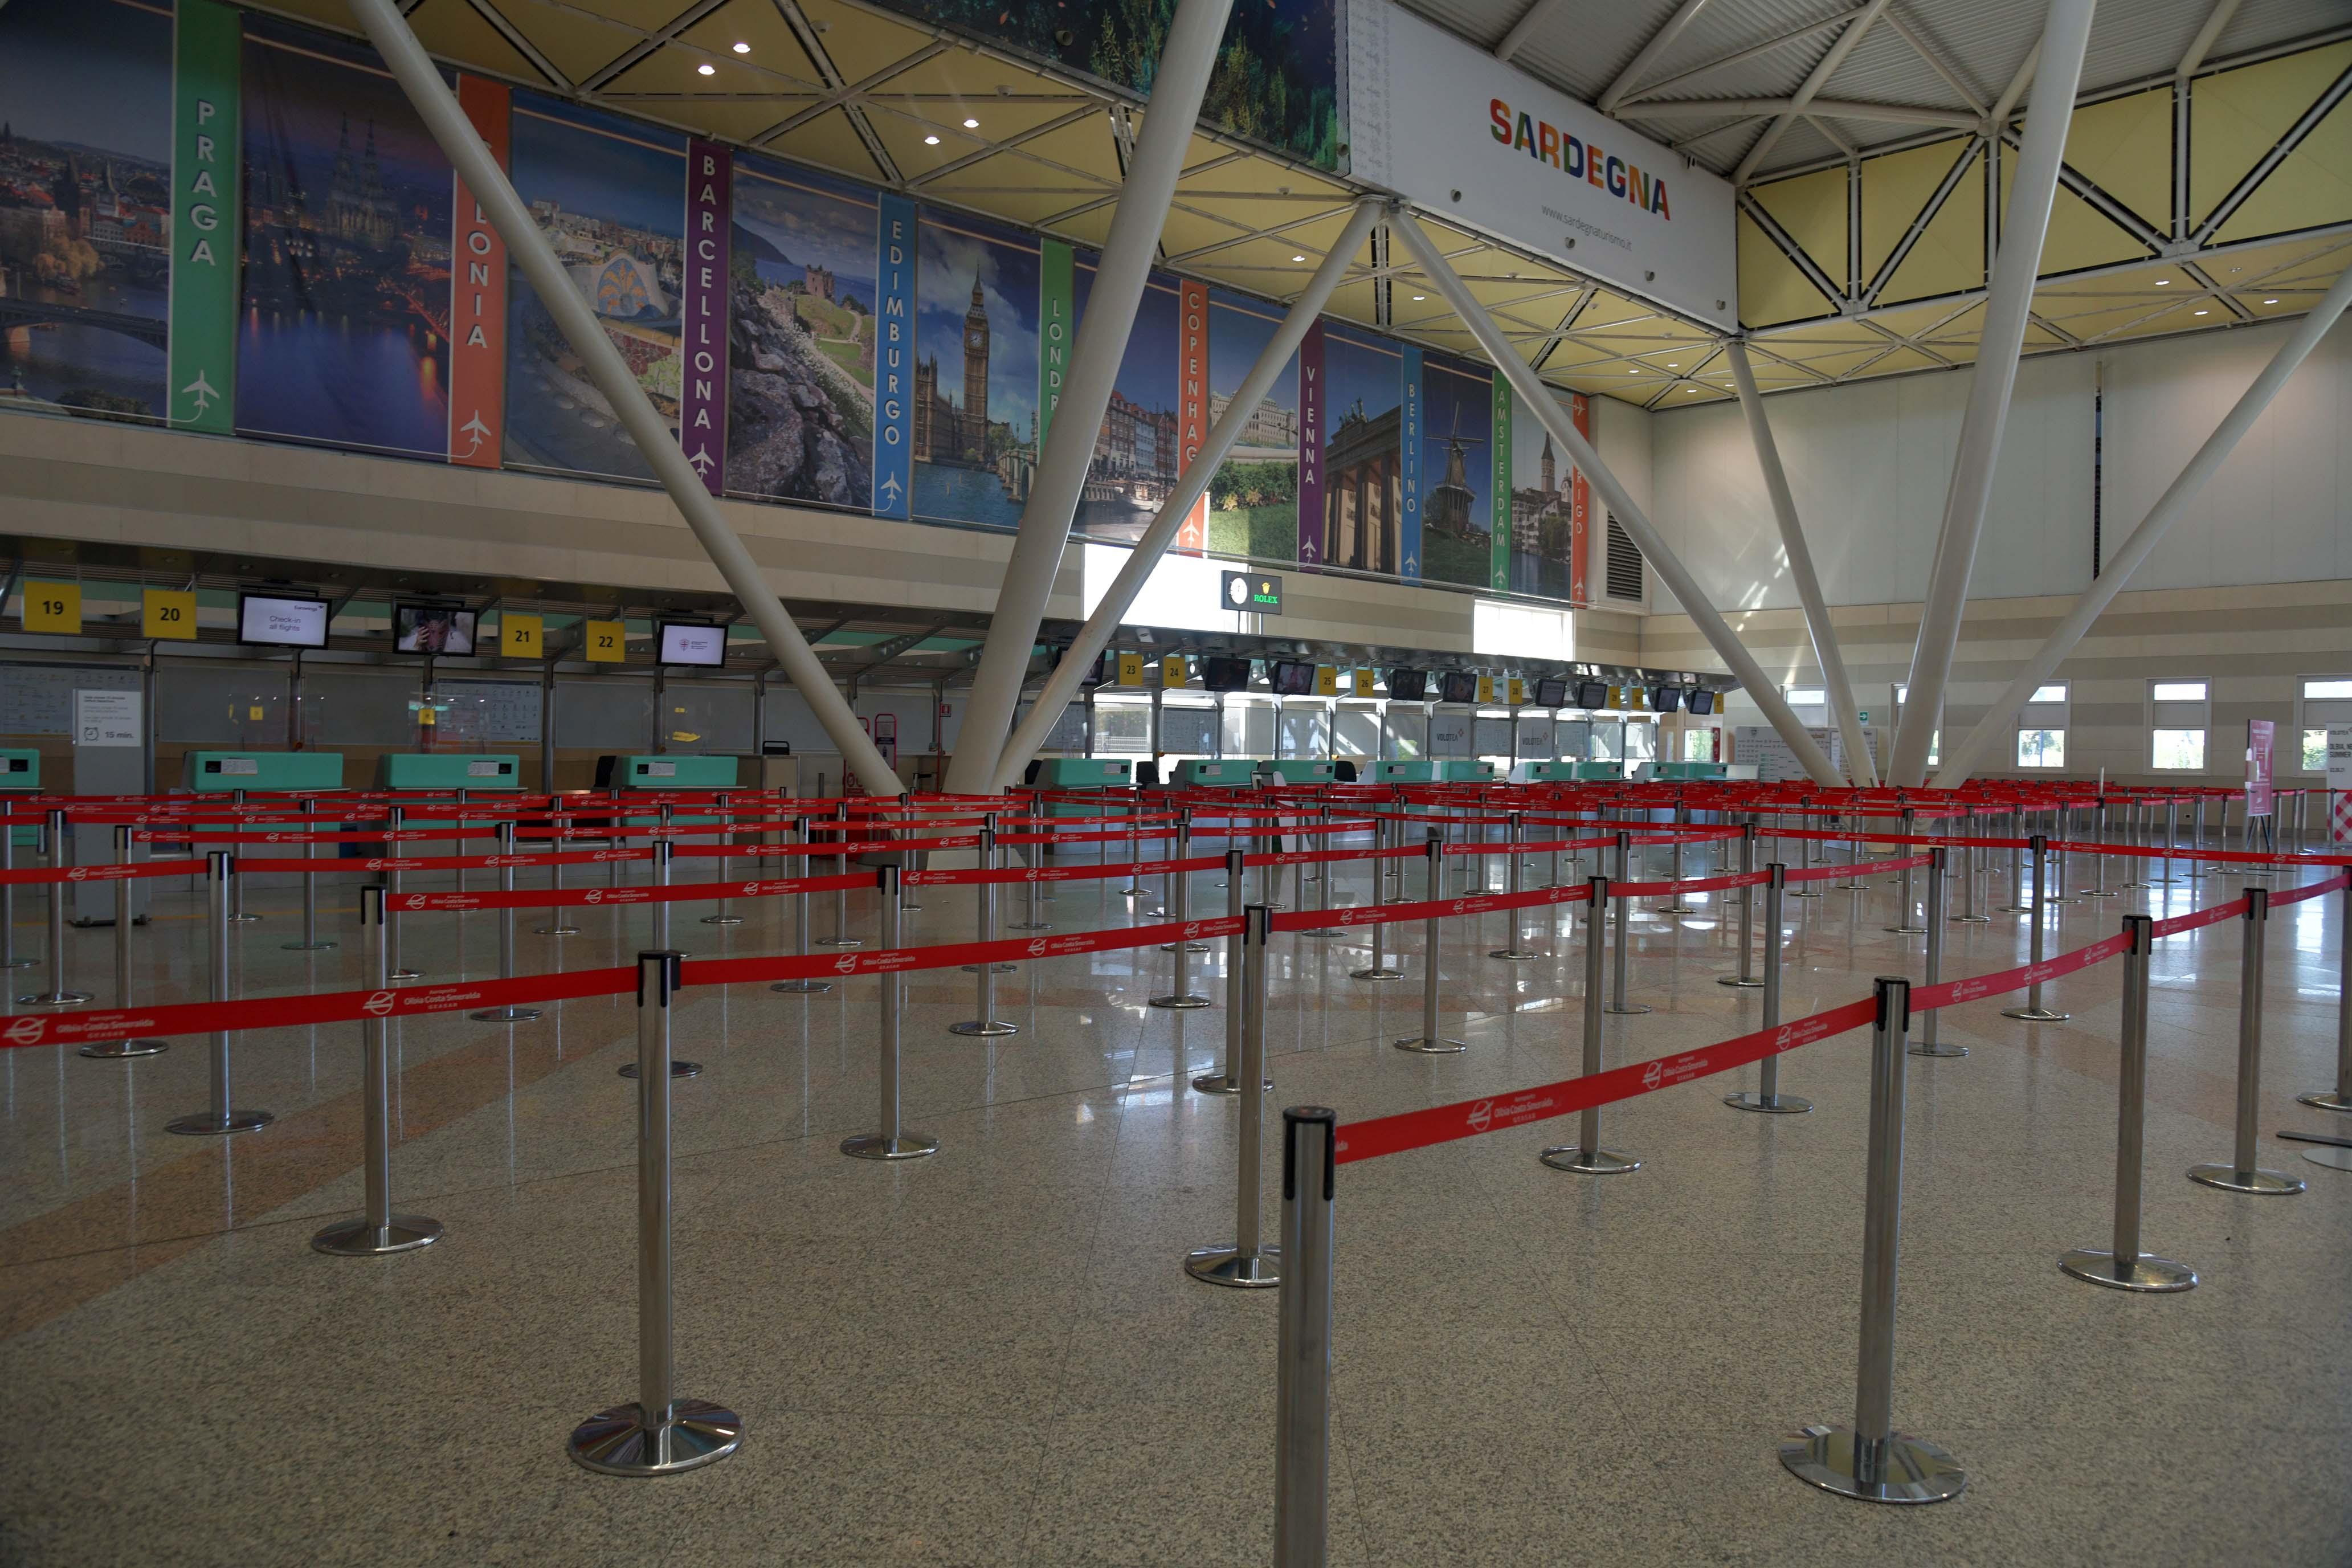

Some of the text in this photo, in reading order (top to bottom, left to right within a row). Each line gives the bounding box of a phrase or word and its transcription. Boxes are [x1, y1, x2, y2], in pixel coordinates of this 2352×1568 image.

[190, 99, 218, 267] PRAGA
[1489, 98, 1671, 221] SARDEGNA
[466, 140, 493, 348] LONIA
[1541, 205, 1632, 251] www.sardegnaturismo.it
[693, 155, 717, 430] BARCELLONA
[884, 219, 904, 446] EDIMBURGO
[1049, 299, 1063, 411] LONDR
[1186, 292, 1199, 463] COPENHAG
[1305, 366, 1316, 485] VIENNA
[1407, 383, 1416, 512] BERLINO
[1495, 390, 1507, 548] AMSTERDAM
[43, 601, 64, 615] 19
[160, 607, 181, 621] 20
[516, 630, 529, 643] 21
[599, 636, 613, 648] 22
[1253, 594, 1278, 604] ROLEX
[1126, 665, 1136, 675] 23
[1170, 668, 1179, 677] 24
[446, 991, 481, 1001] Smeralda
